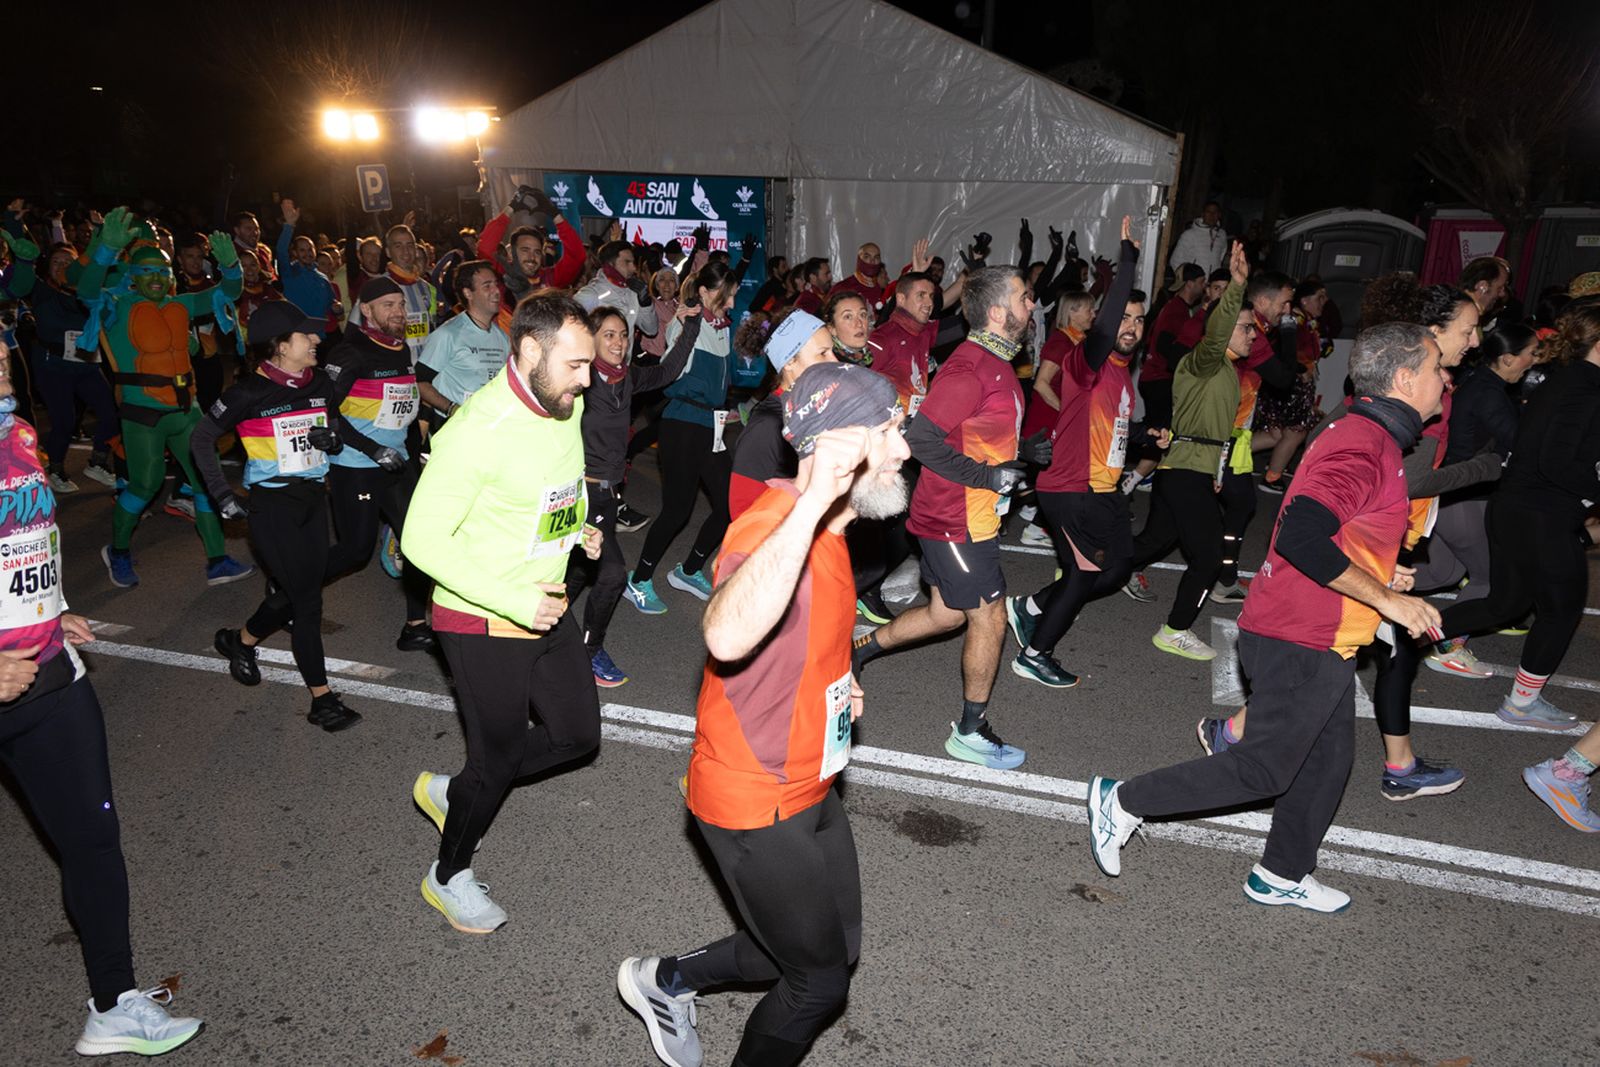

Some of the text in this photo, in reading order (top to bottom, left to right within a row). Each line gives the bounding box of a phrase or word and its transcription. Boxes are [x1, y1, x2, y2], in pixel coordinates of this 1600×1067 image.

[364, 171, 383, 195] P
[627, 181, 679, 199] 43 SAN
[623, 196, 677, 215] ANTÓN
[176, 374, 187, 387] L
[261, 403, 292, 417] inacua
[392, 400, 414, 415] 1765
[12, 539, 48, 557] NOCHE DE
[2, 558, 21, 571] SAN
[9, 558, 58, 597] 4503
